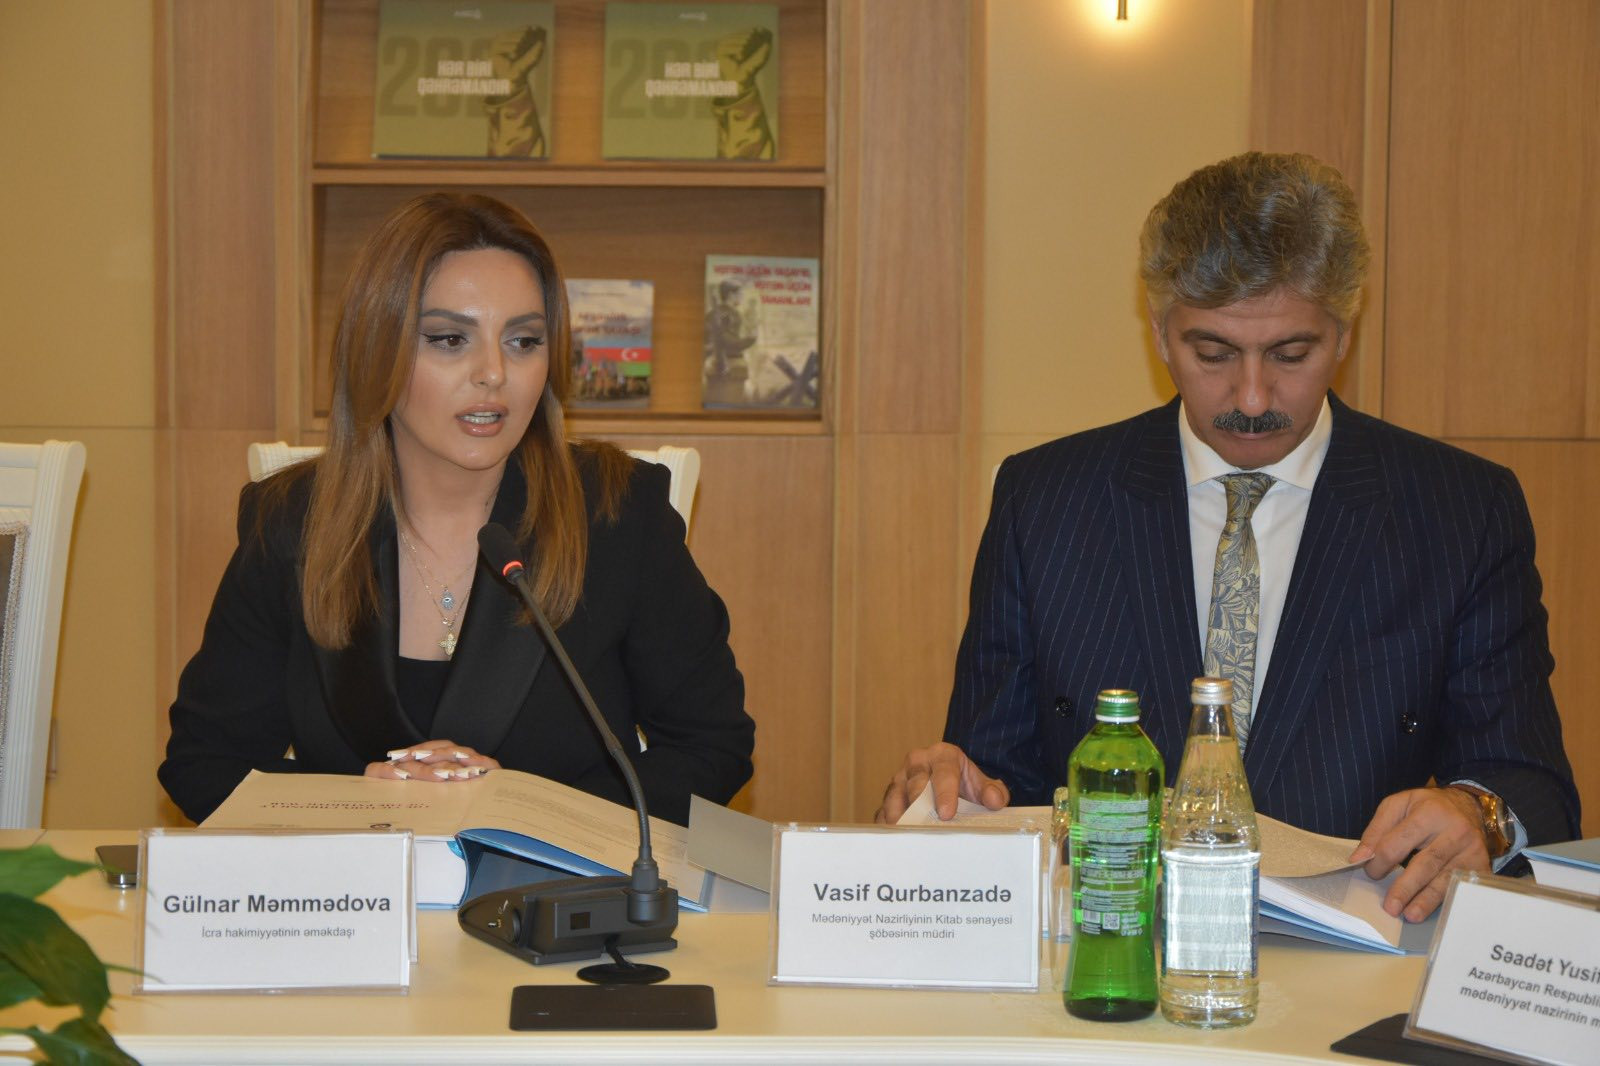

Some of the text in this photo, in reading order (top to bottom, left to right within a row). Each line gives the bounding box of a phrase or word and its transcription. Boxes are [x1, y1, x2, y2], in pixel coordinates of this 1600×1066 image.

[813, 883, 1012, 903] Vasif Qurbanzadə
[163, 894, 391, 914] Gülnar Məmmədova
[811, 913, 1013, 927] Mədəniyyət Nazirliyinin Kitab sənayesi
[201, 926, 356, 940] İcra hakimiyyətinin əməkdaşı
[868, 928, 955, 940] şöbəsinin müdiri
[1490, 944, 1553, 973] Səadət
[1468, 966, 1600, 1008] Azərbaycan Respubli
[1459, 986, 1532, 1012] mədəniyyət
[1534, 1003, 1588, 1025] nazirinin
